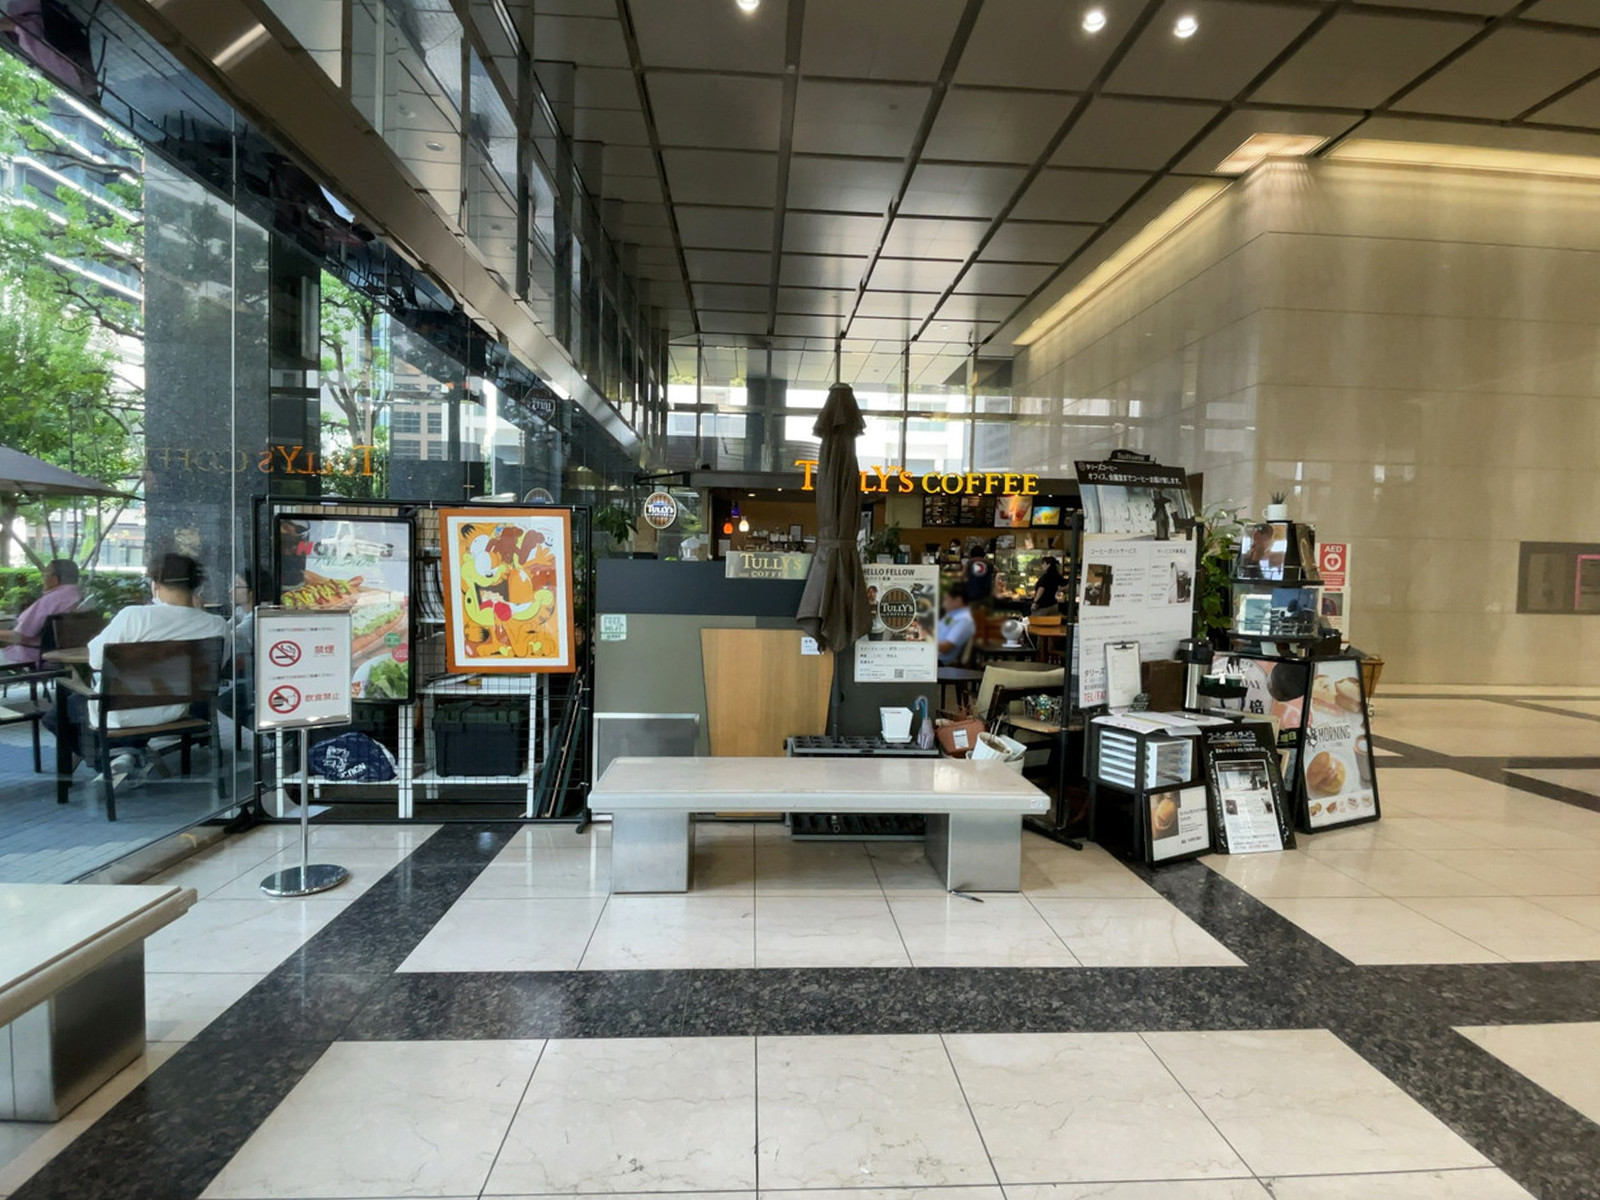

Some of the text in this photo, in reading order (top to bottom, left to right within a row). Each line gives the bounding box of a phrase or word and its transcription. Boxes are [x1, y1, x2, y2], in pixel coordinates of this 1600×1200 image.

[794, 459, 1040, 496] TLY'S COFFEE
[647, 504, 675, 514] TULLY'S
[1324, 545, 1343, 553] AED
[739, 552, 801, 570] TULLY'S
[886, 568, 915, 576] FELLOW
[881, 602, 914, 612] TULLY'S
